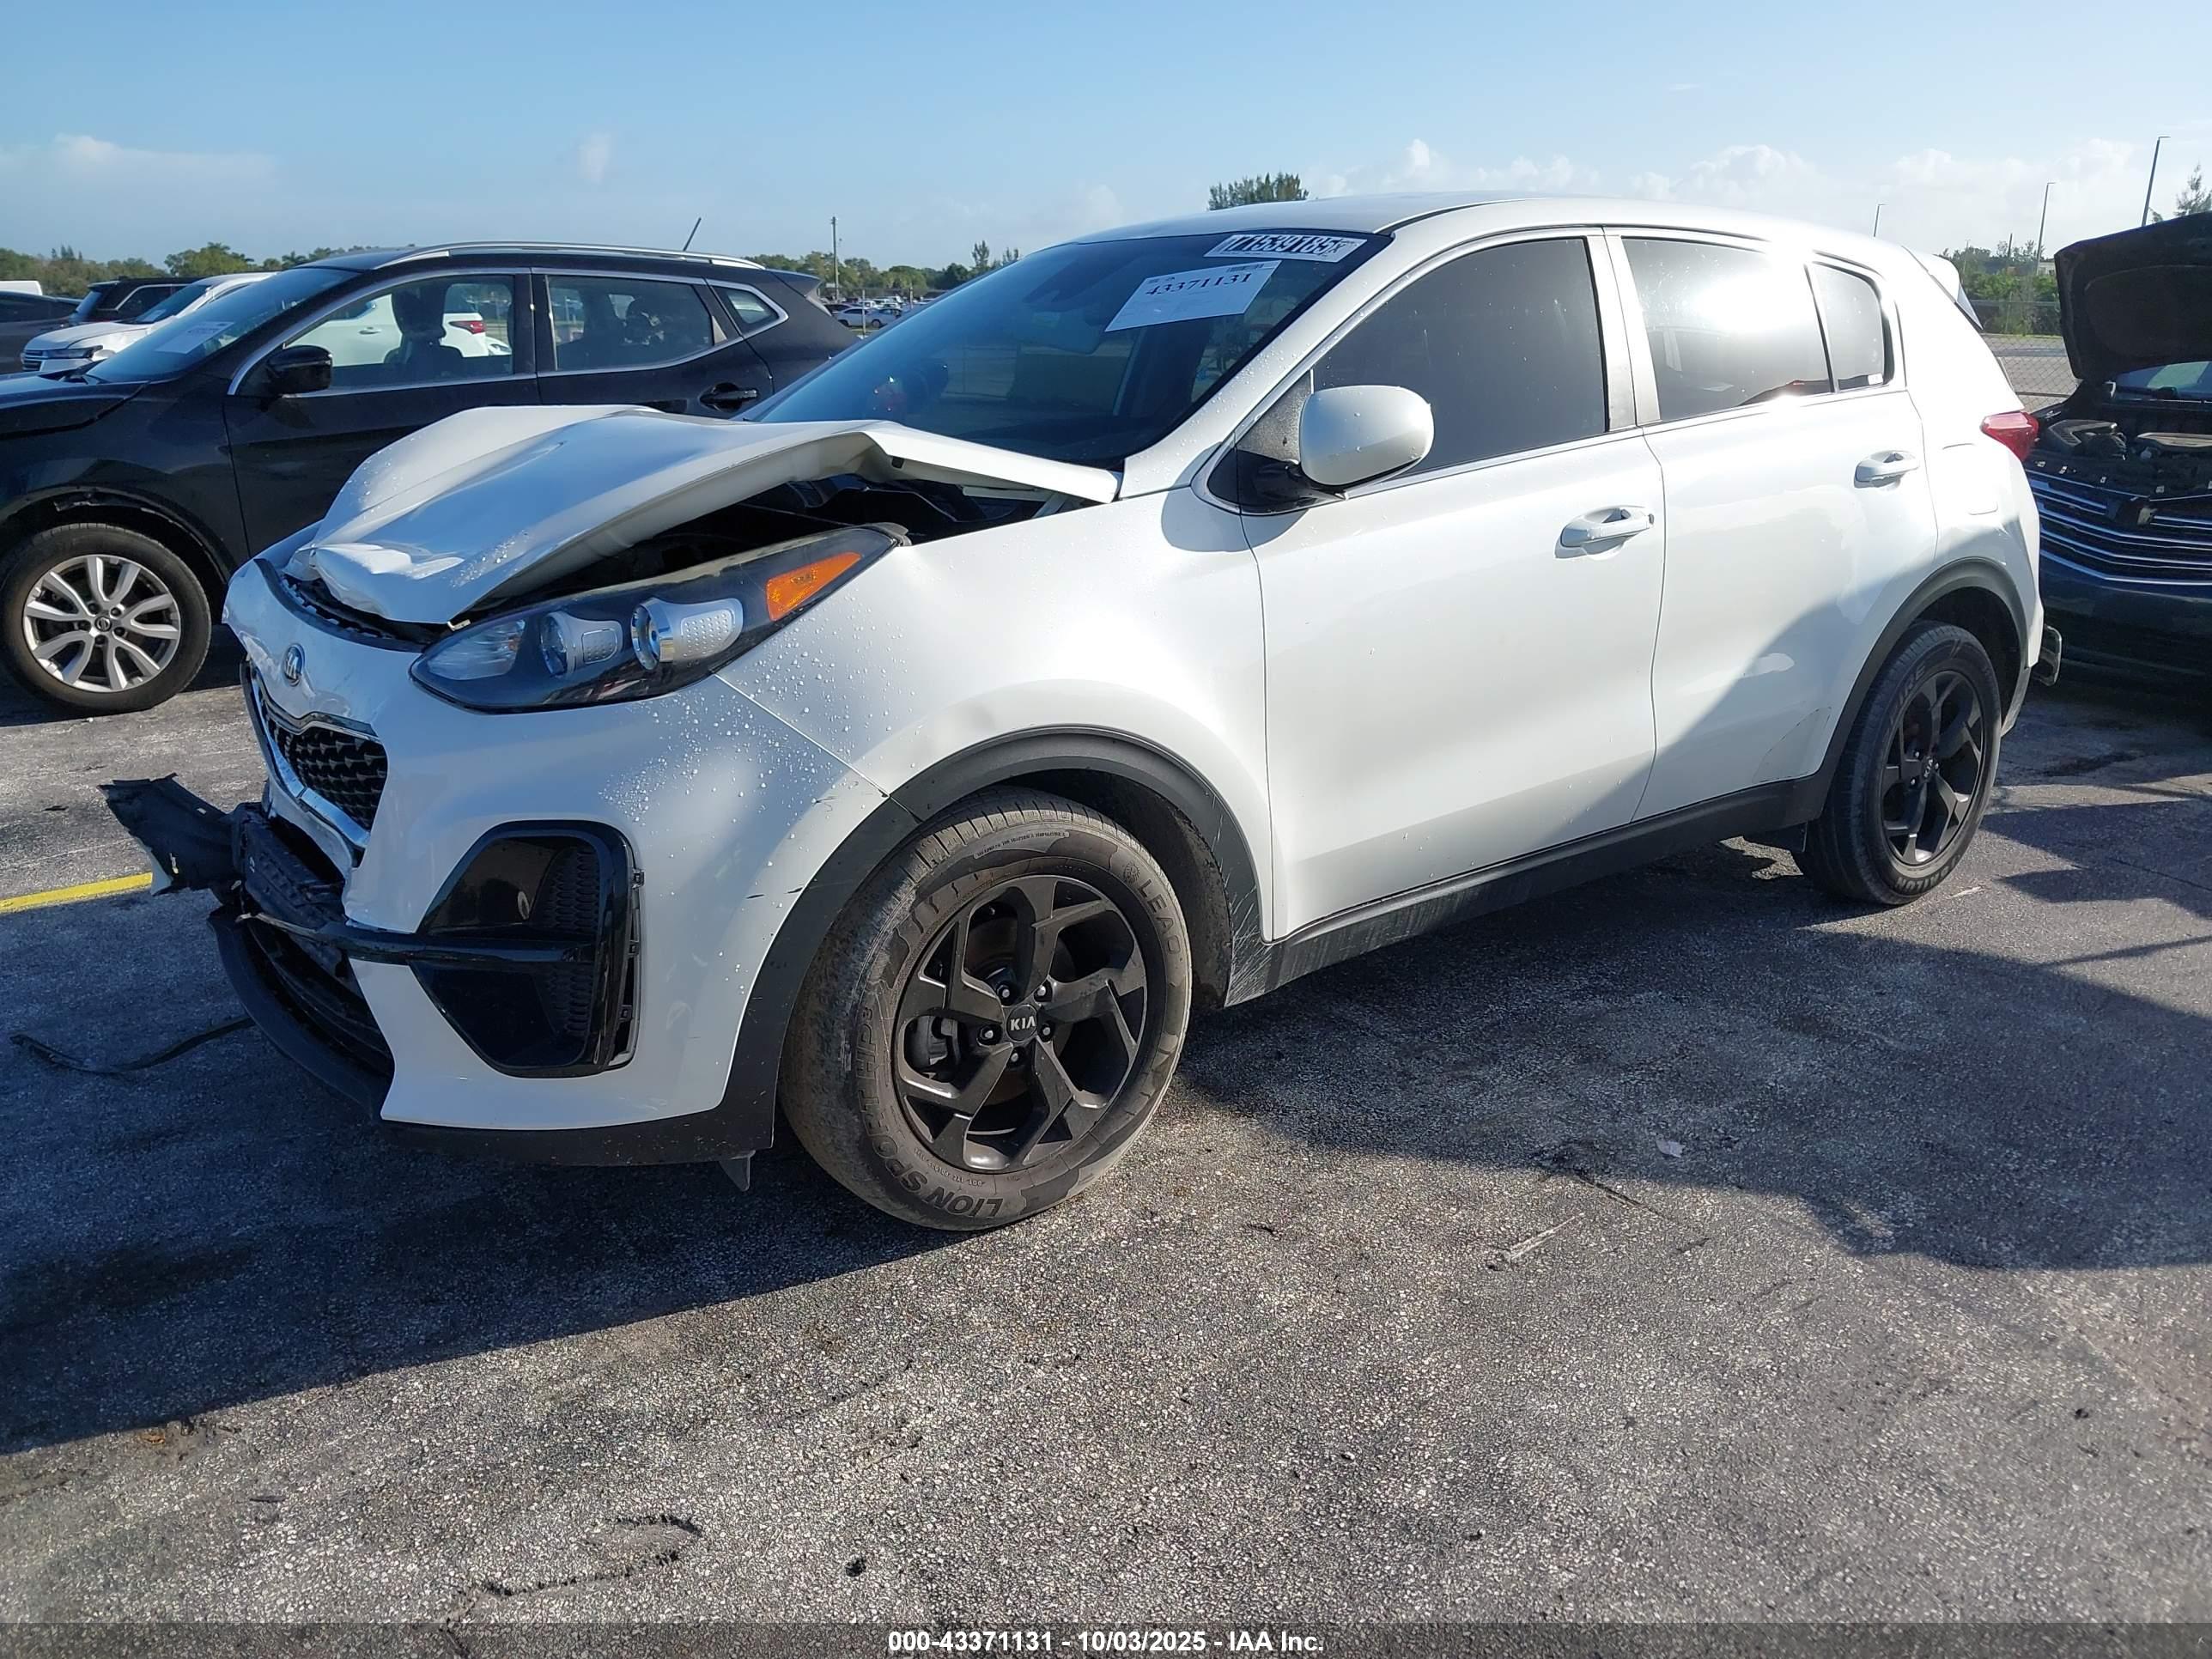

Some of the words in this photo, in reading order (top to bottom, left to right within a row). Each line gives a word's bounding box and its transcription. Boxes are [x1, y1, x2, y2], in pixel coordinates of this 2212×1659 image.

[1146, 273, 1252, 296] 43371131
[1138, 879, 1182, 955] LEAO
[1011, 1016, 1036, 1030] KIA
[859, 1090, 928, 1193] SPORT
[924, 1186, 1004, 1218] LION
